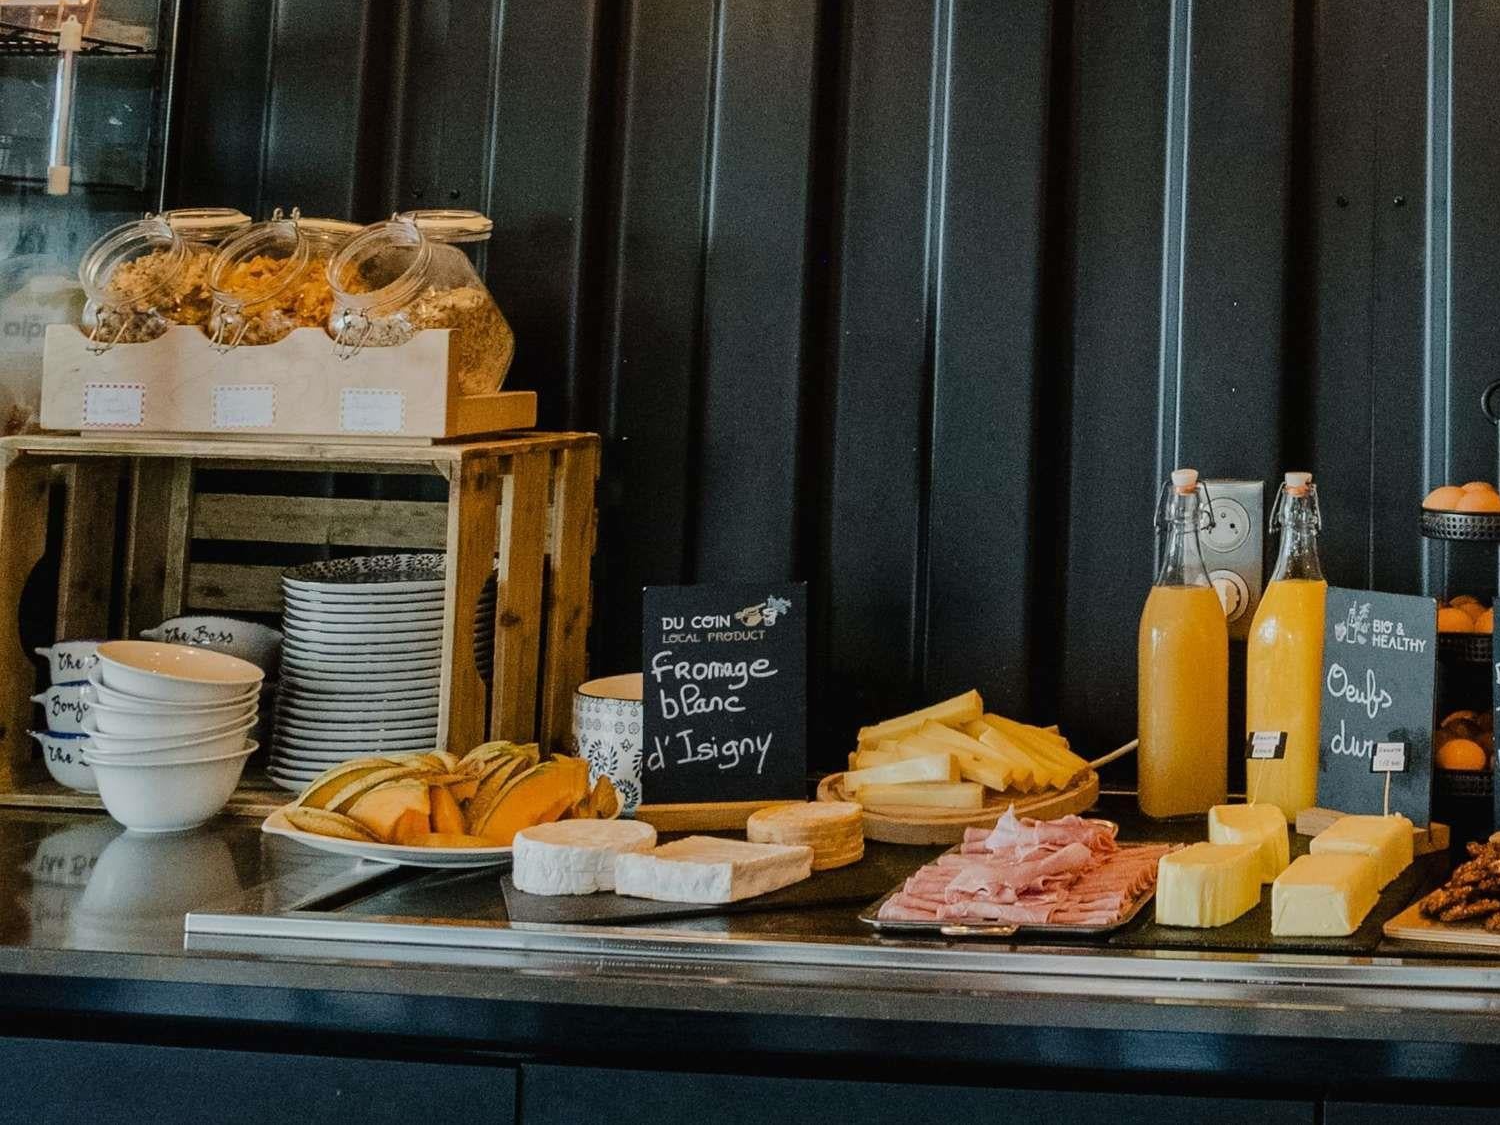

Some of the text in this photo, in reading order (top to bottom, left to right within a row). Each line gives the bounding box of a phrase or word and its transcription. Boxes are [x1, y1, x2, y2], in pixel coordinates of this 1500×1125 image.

[662, 615, 731, 630] DU COIN
[1372, 619, 1405, 636] BIO &
[662, 630, 766, 644] LOCAL PRODUCT
[1372, 634, 1427, 653] HEALTHY
[659, 683, 746, 719] blanc
[1326, 662, 1393, 719] Oeufs
[647, 729, 773, 774] d'Isigny
[1330, 719, 1374, 758] dur
